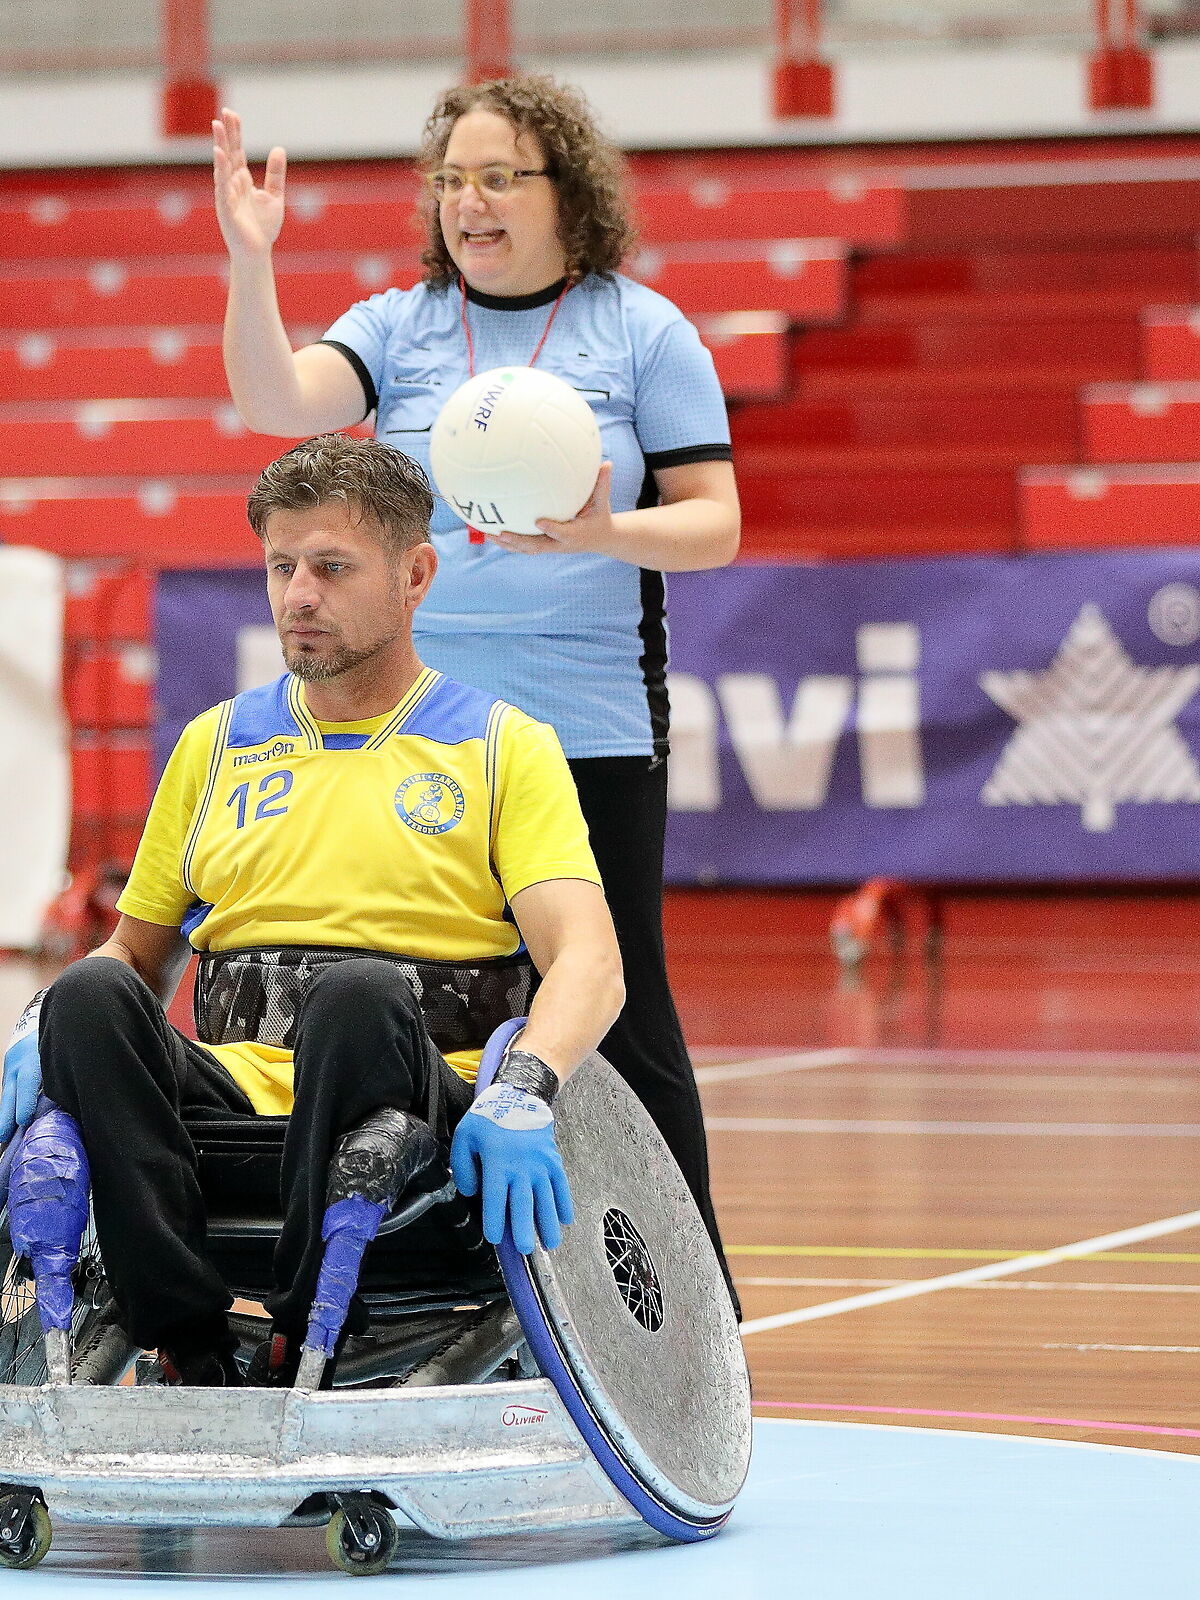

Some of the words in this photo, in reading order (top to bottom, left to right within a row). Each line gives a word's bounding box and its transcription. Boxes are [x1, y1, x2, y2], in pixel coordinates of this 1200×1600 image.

[472, 384, 505, 432] IWRF
[452, 495, 505, 524] ITA
[233, 741, 295, 768] macron
[226, 769, 294, 829] 12
[406, 819, 442, 834] VERONA
